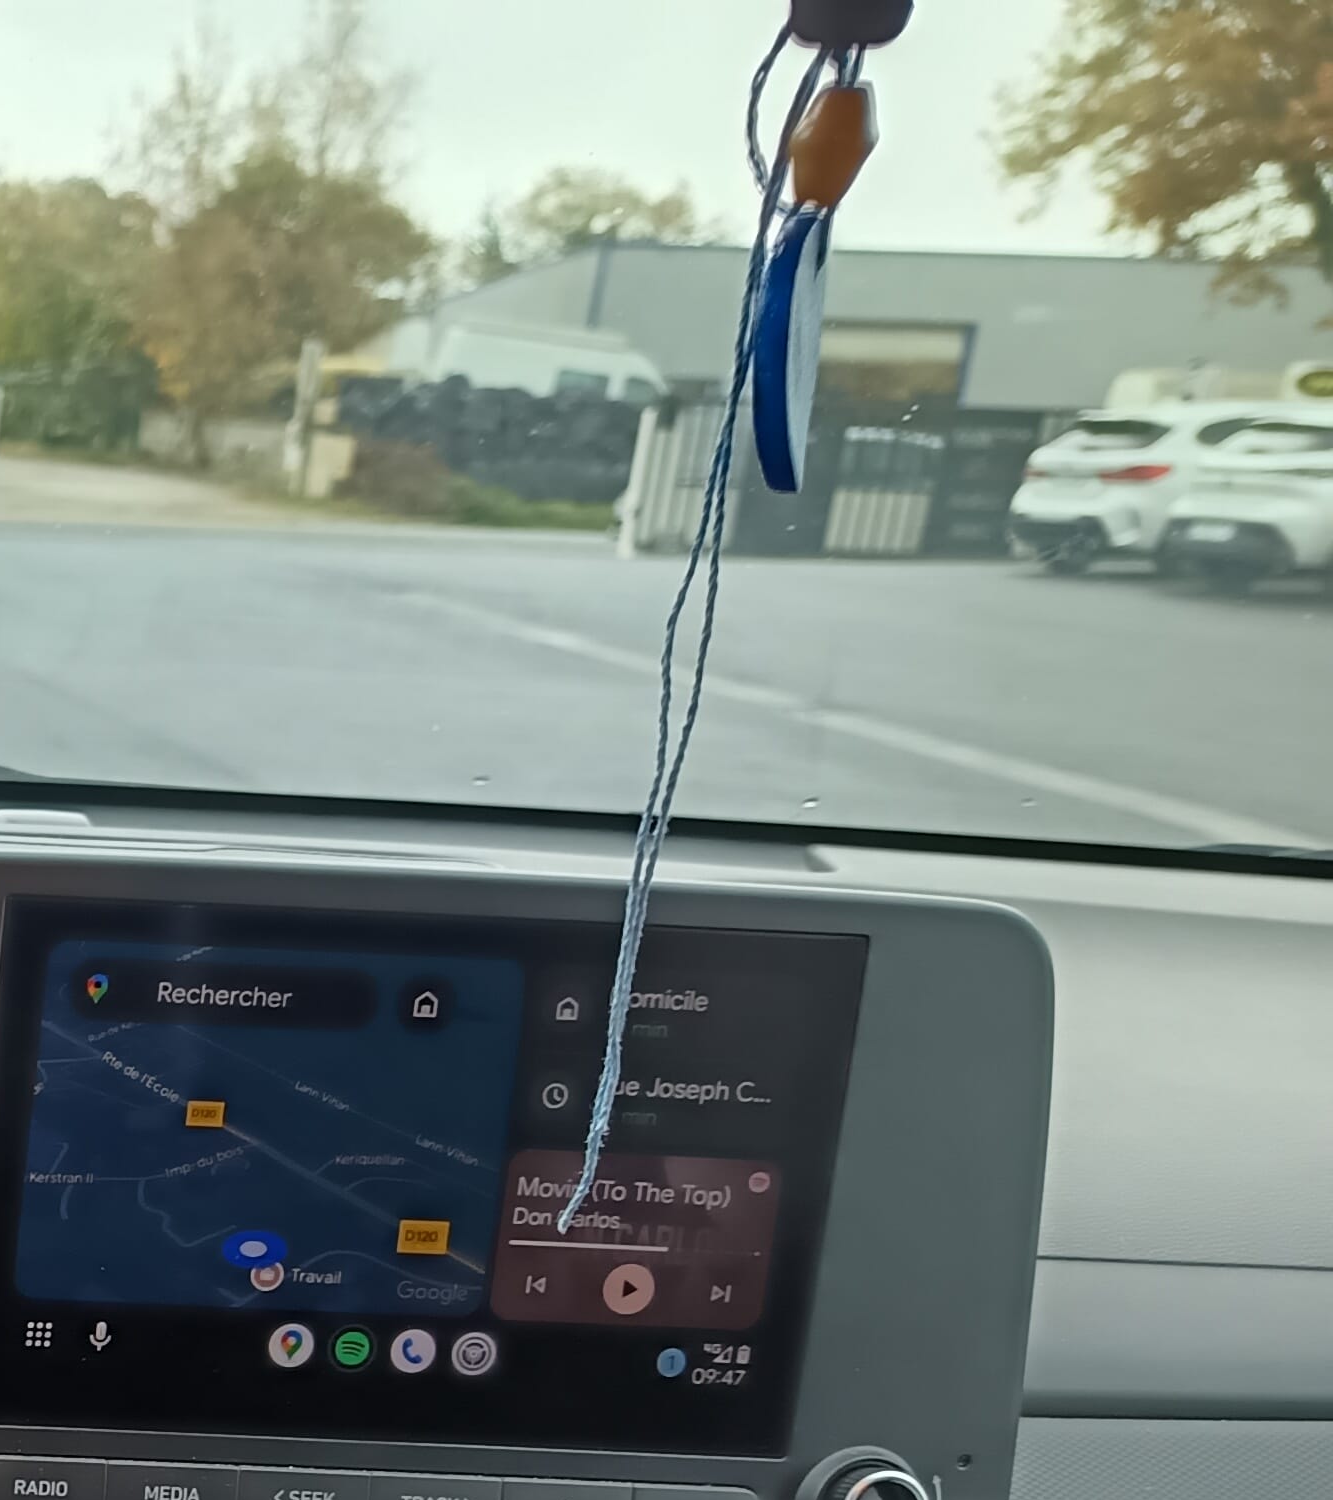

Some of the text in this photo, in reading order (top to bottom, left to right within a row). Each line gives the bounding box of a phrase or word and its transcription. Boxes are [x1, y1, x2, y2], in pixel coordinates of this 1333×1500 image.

[157, 981, 292, 1008] Rechercher
[610, 987, 709, 1012] omicile
[123, 1065, 140, 1080] de
[646, 1077, 730, 1104] Joseph
[592, 1179, 627, 1202] (To
[634, 1182, 675, 1204] The
[682, 1184, 732, 1210] Top)
[513, 1206, 621, 1229] Don arlos
[404, 1229, 439, 1244] D120
[291, 1268, 342, 1286] Travail
[396, 1280, 469, 1305] Google
[692, 1367, 746, 1386] 09:47
[14, 1478, 68, 1499] RADIO
